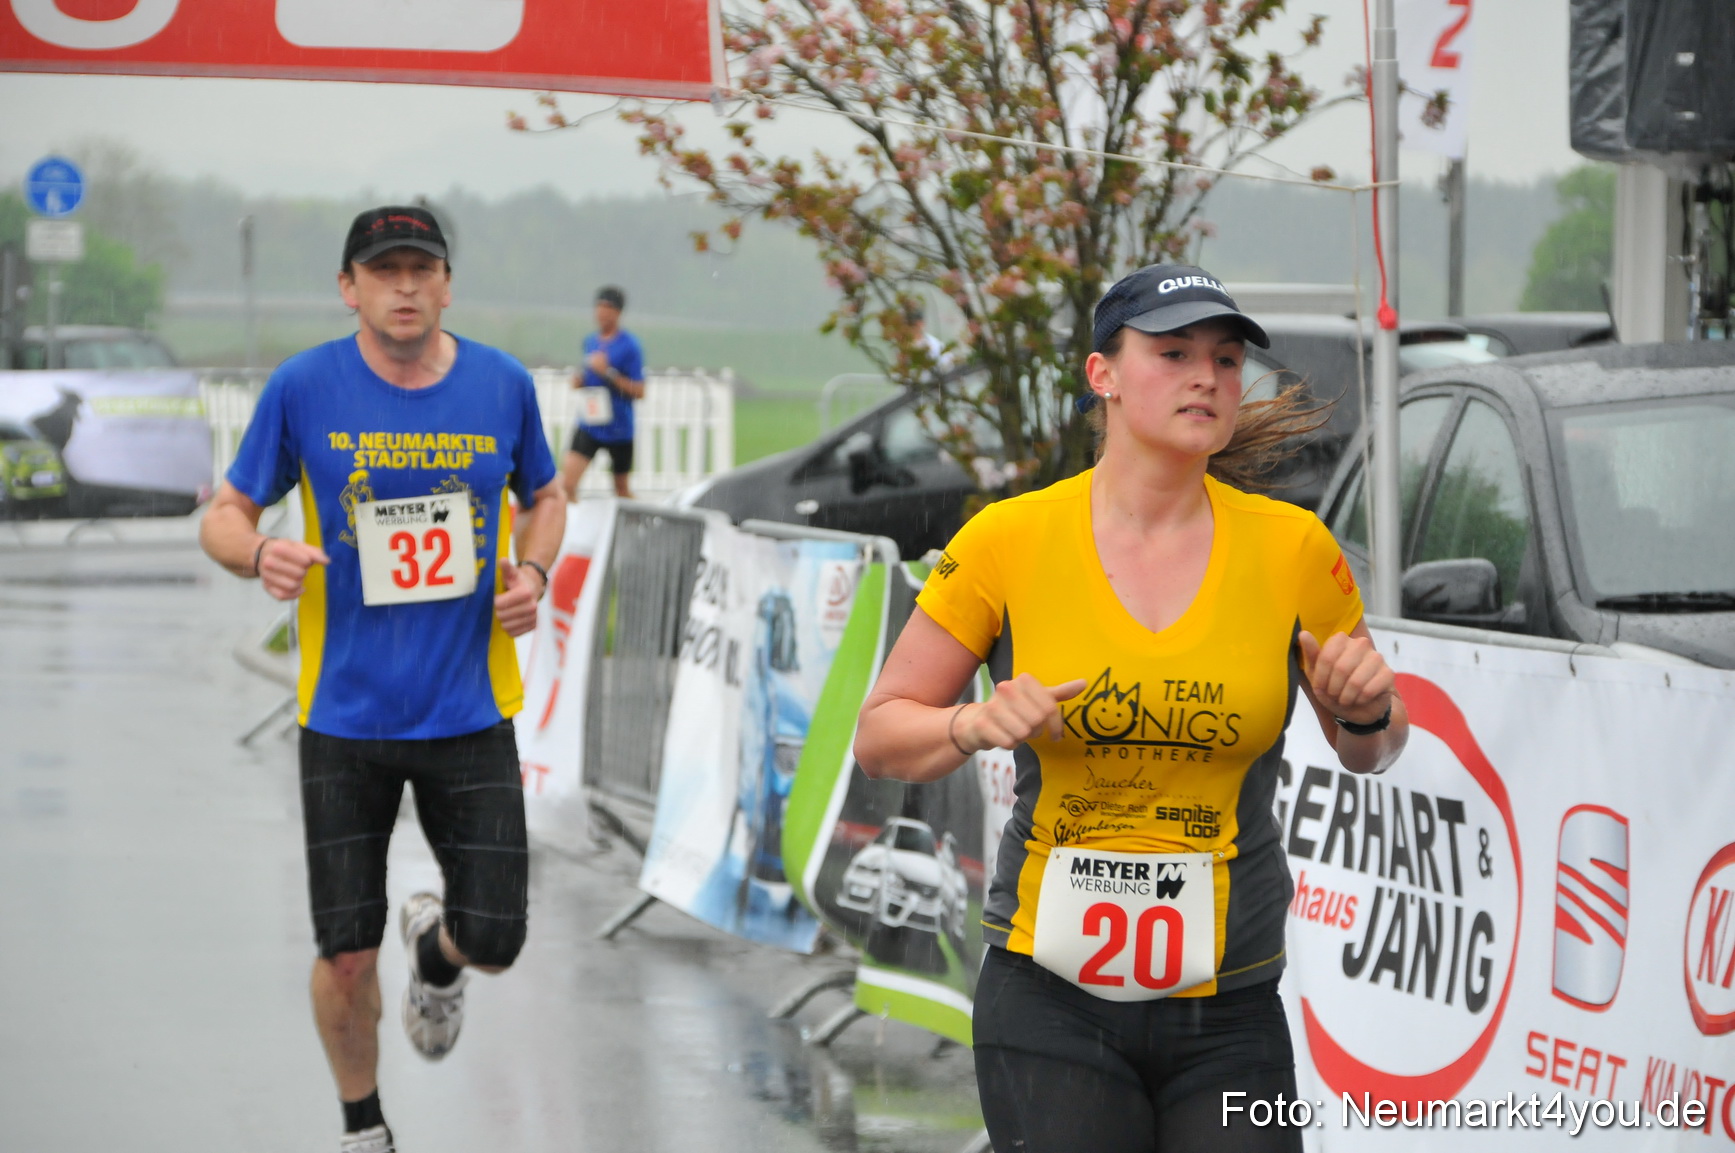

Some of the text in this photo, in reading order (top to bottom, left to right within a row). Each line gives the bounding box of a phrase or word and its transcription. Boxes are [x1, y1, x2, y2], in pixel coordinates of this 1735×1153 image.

[1158, 276, 1232, 300] QUELL
[327, 431, 497, 454] 10. NEUMARKTER
[353, 450, 474, 469] STADTLAUF
[374, 502, 426, 517] MEYER
[374, 514, 428, 527] WERBUNG
[388, 527, 454, 590] 32
[1163, 679, 1224, 705] TEAM
[1084, 747, 1214, 764] APOTHEKE
[1478, 827, 1494, 879] &
[1070, 857, 1151, 881] MEYER
[1069, 876, 1151, 896] WERBUNG
[1291, 870, 1359, 931] haus
[1078, 901, 1185, 990] 20
[1342, 885, 1496, 1015] JÄNIG
[1525, 1030, 1628, 1104] SEAT
